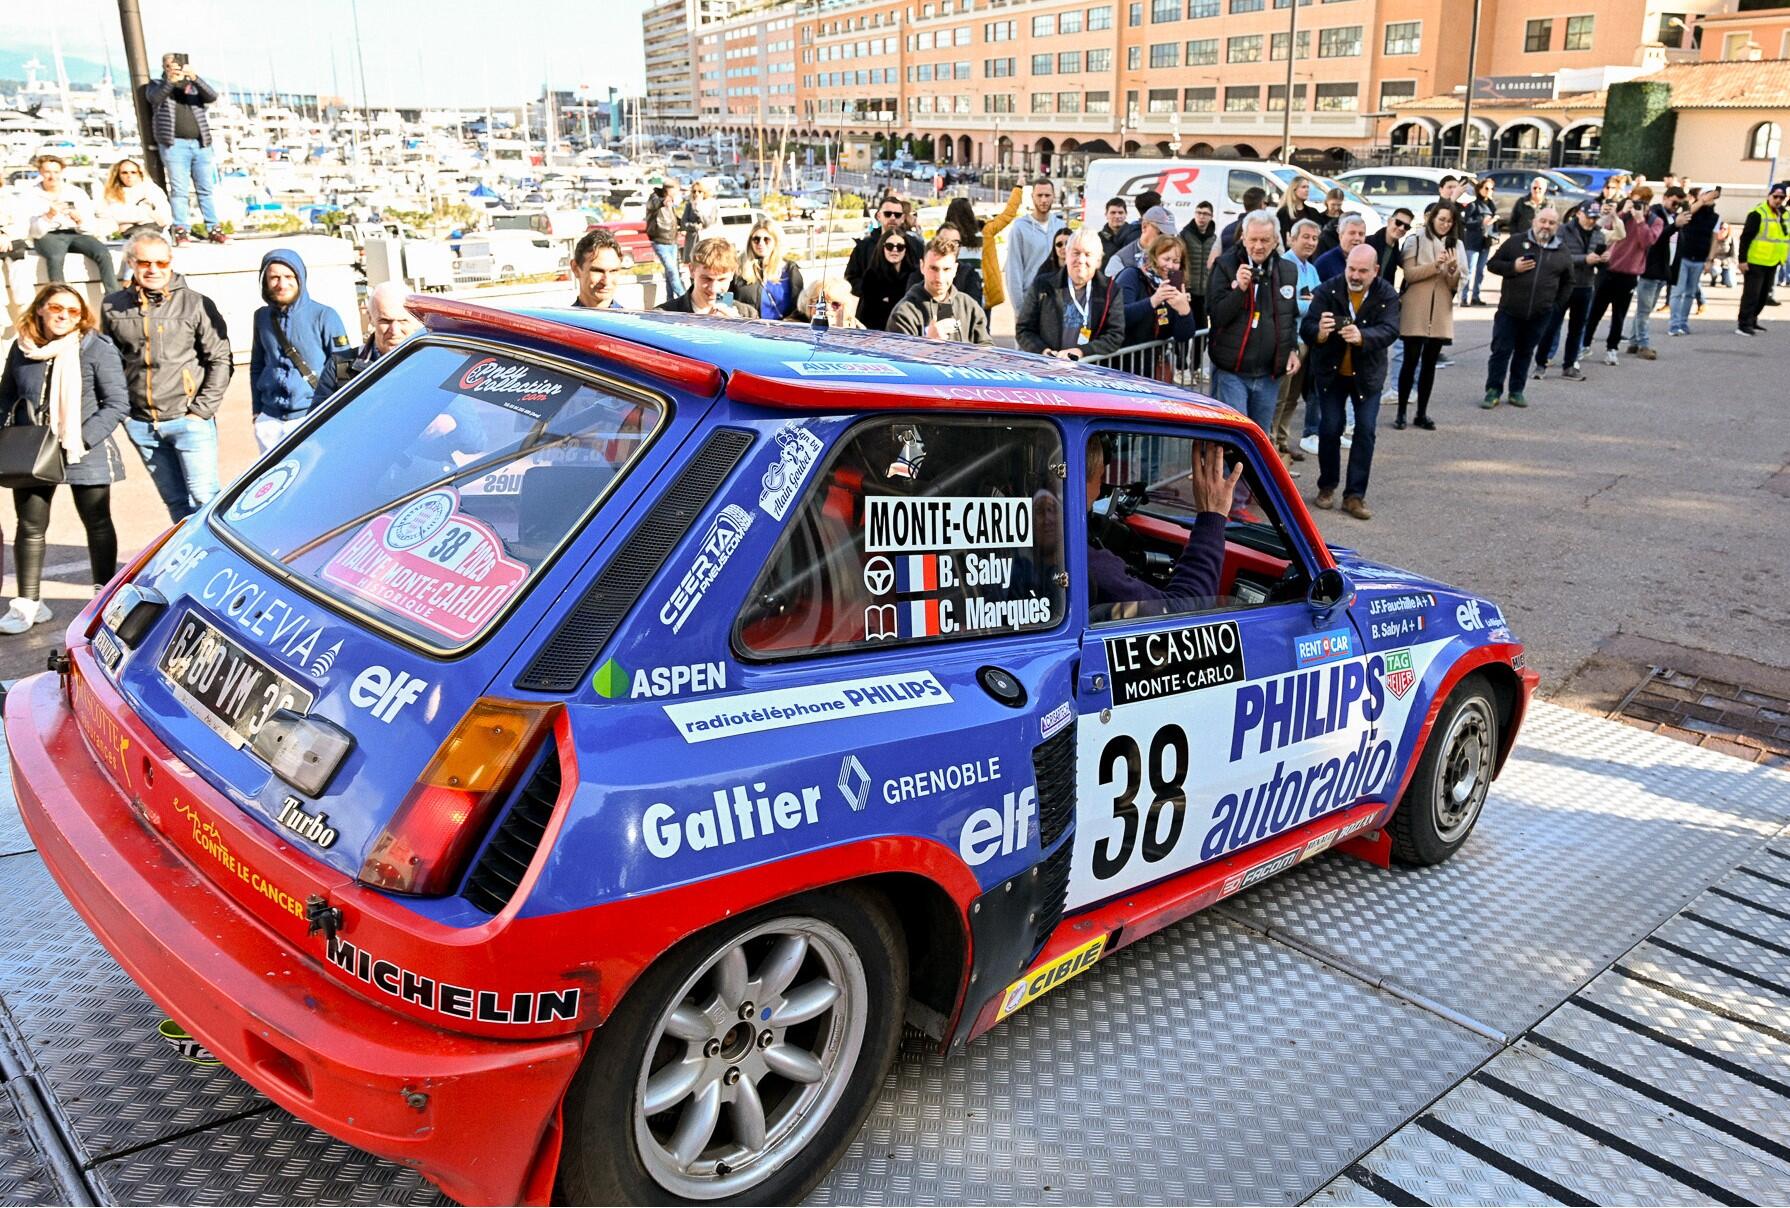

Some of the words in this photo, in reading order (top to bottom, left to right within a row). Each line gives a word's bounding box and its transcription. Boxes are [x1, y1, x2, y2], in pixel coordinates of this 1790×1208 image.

[1116, 167, 1200, 196] GR
[428, 527, 472, 563] 38
[869, 501, 1029, 546] MONTE-CARLO
[337, 529, 393, 579] RALLYE
[384, 562, 510, 624] MONTE-CARLO
[459, 541, 497, 583] 2026
[939, 554, 960, 588] B.
[965, 553, 1013, 589] Saby
[202, 567, 325, 668] CYCLEVIA
[357, 578, 435, 618] HISTORIQUE
[939, 599, 960, 633] C.
[965, 590, 1051, 631] Marquès
[1456, 599, 1485, 631] elf
[1111, 637, 1141, 673] LE
[1146, 624, 1236, 667] CASINO
[1299, 639, 1322, 658] RENT
[1330, 636, 1349, 653] CAR
[1371, 624, 1382, 639] B.
[1381, 621, 1401, 637] Saby
[630, 661, 727, 699] ASPEN
[1386, 654, 1410, 669] TAG
[1387, 672, 1413, 695] HEUER
[348, 665, 429, 725] elf
[685, 698, 845, 733] radiotéléphone
[842, 679, 942, 707] PHILIPS
[1229, 654, 1385, 763] PHILIPS
[882, 756, 1001, 805] GRENOBLE
[1091, 723, 1190, 880] 38
[1200, 727, 1393, 862] autoradio
[277, 796, 336, 849] Turbo
[642, 782, 822, 859] Galtier
[959, 785, 1036, 867] elf
[195, 828, 236, 873] CONTRE
[237, 863, 250, 885] LE
[251, 872, 305, 921] CANCER
[1242, 853, 1295, 889] FACOM
[326, 935, 581, 1025] MICHELIN
[1028, 942, 1102, 996] CIBIÉ
